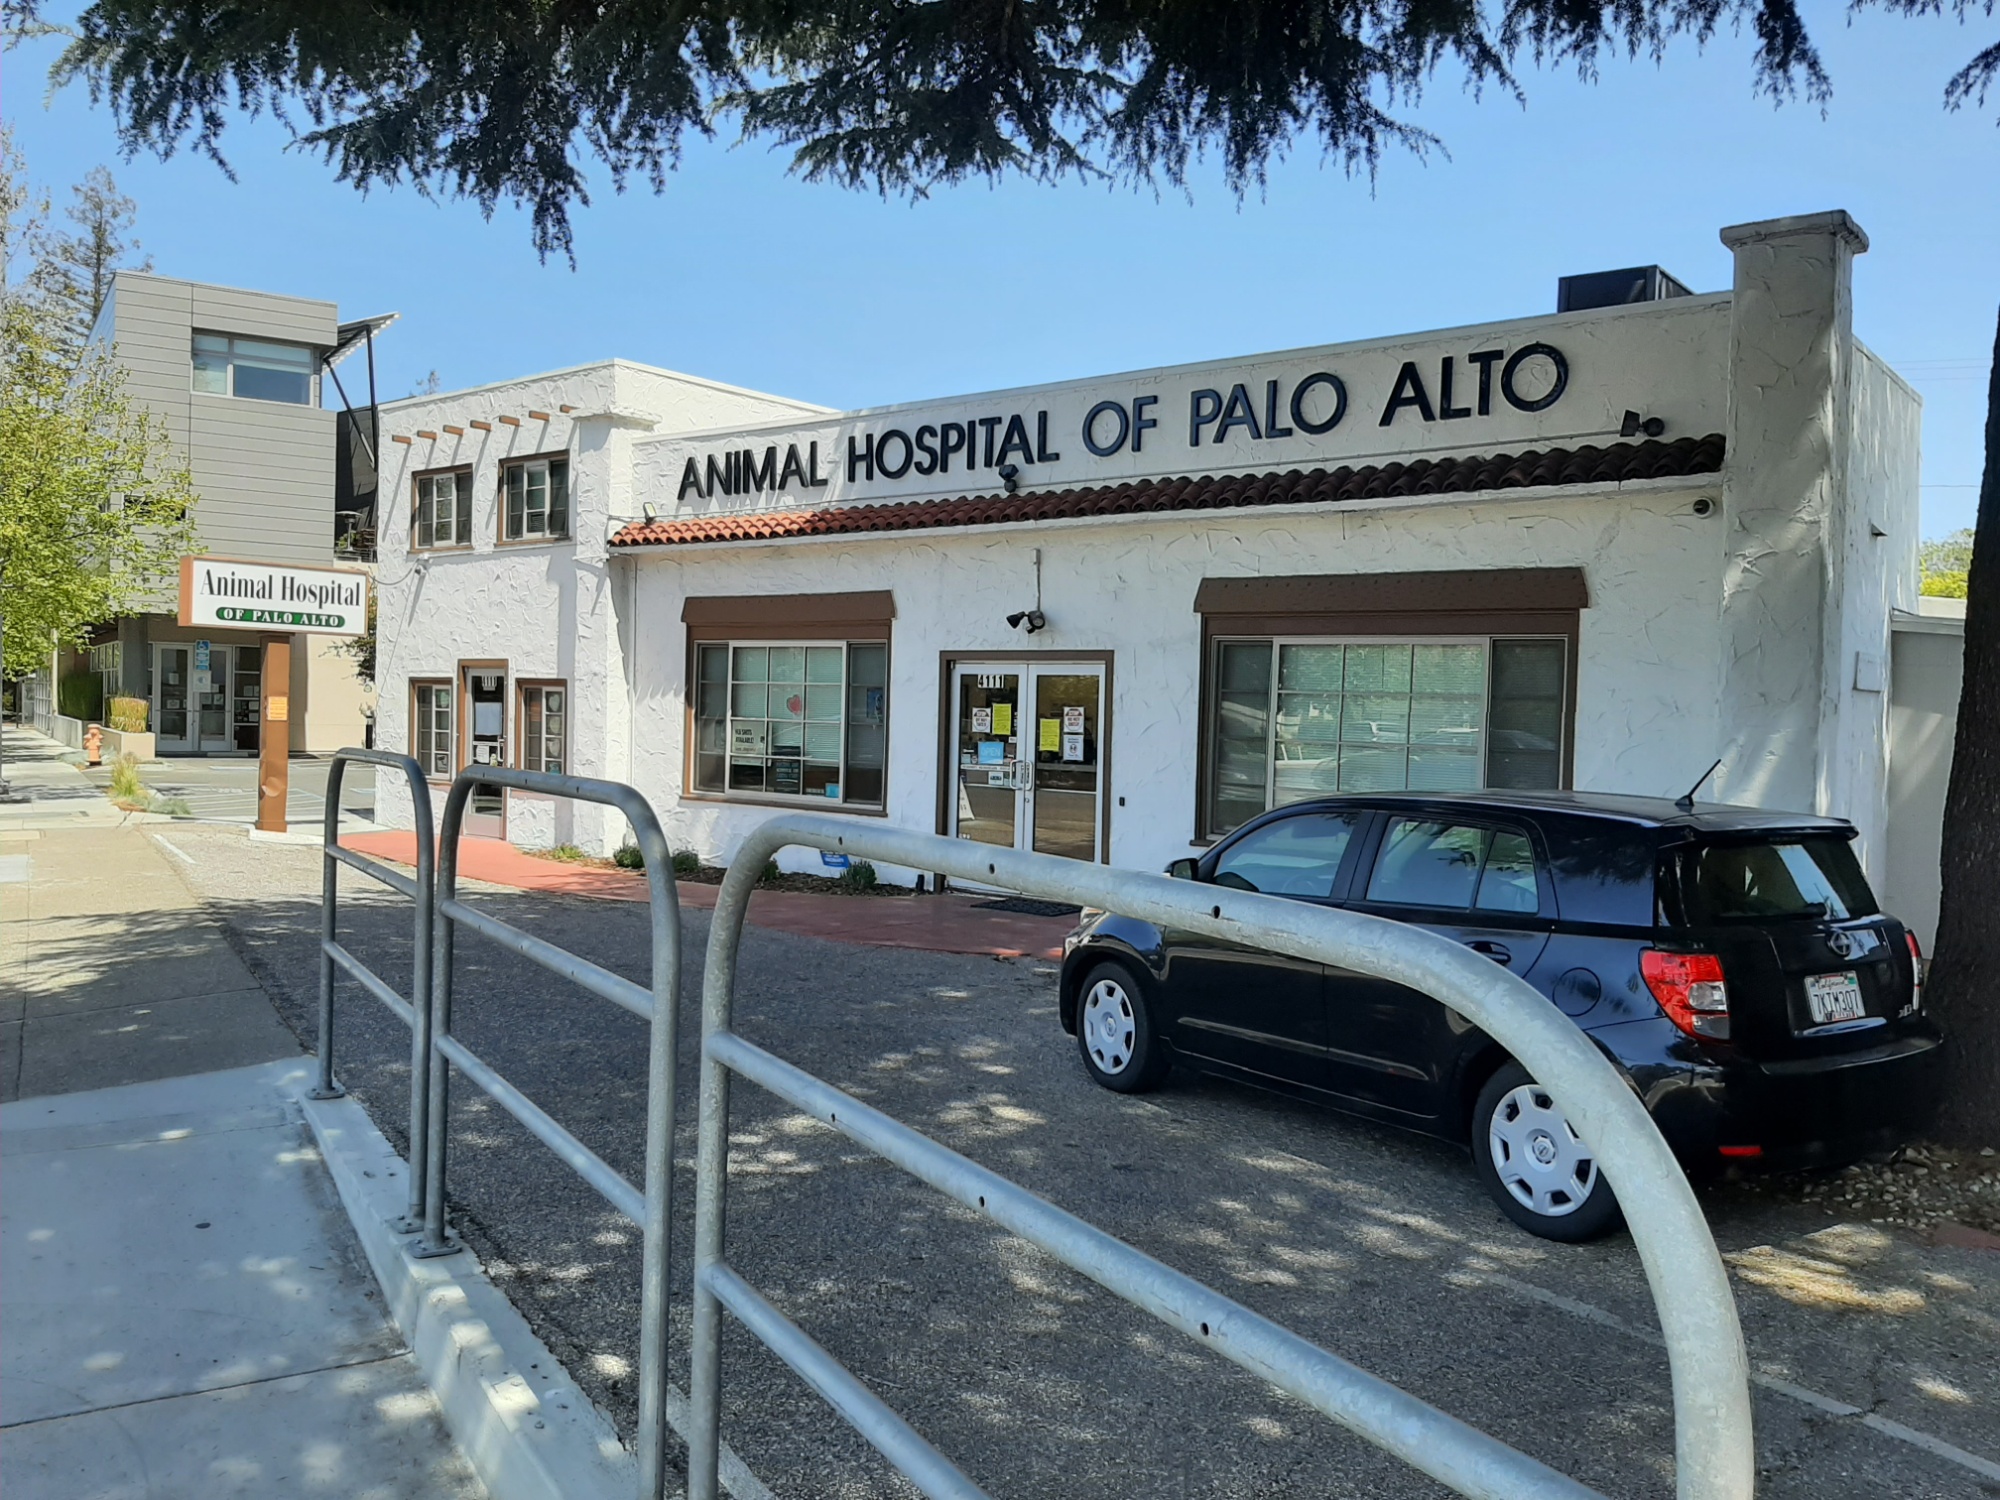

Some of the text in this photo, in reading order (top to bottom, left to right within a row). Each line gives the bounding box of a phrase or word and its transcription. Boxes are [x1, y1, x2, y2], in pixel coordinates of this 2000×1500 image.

[677, 342, 1569, 501] ANIMAL HOSPITAL OF PALO ALTO
[200, 568, 361, 610] Animal Hospital
[223, 608, 339, 627] OF PALO ALTO
[978, 675, 1003, 688] 4111
[980, 746, 1001, 757] OPEN
